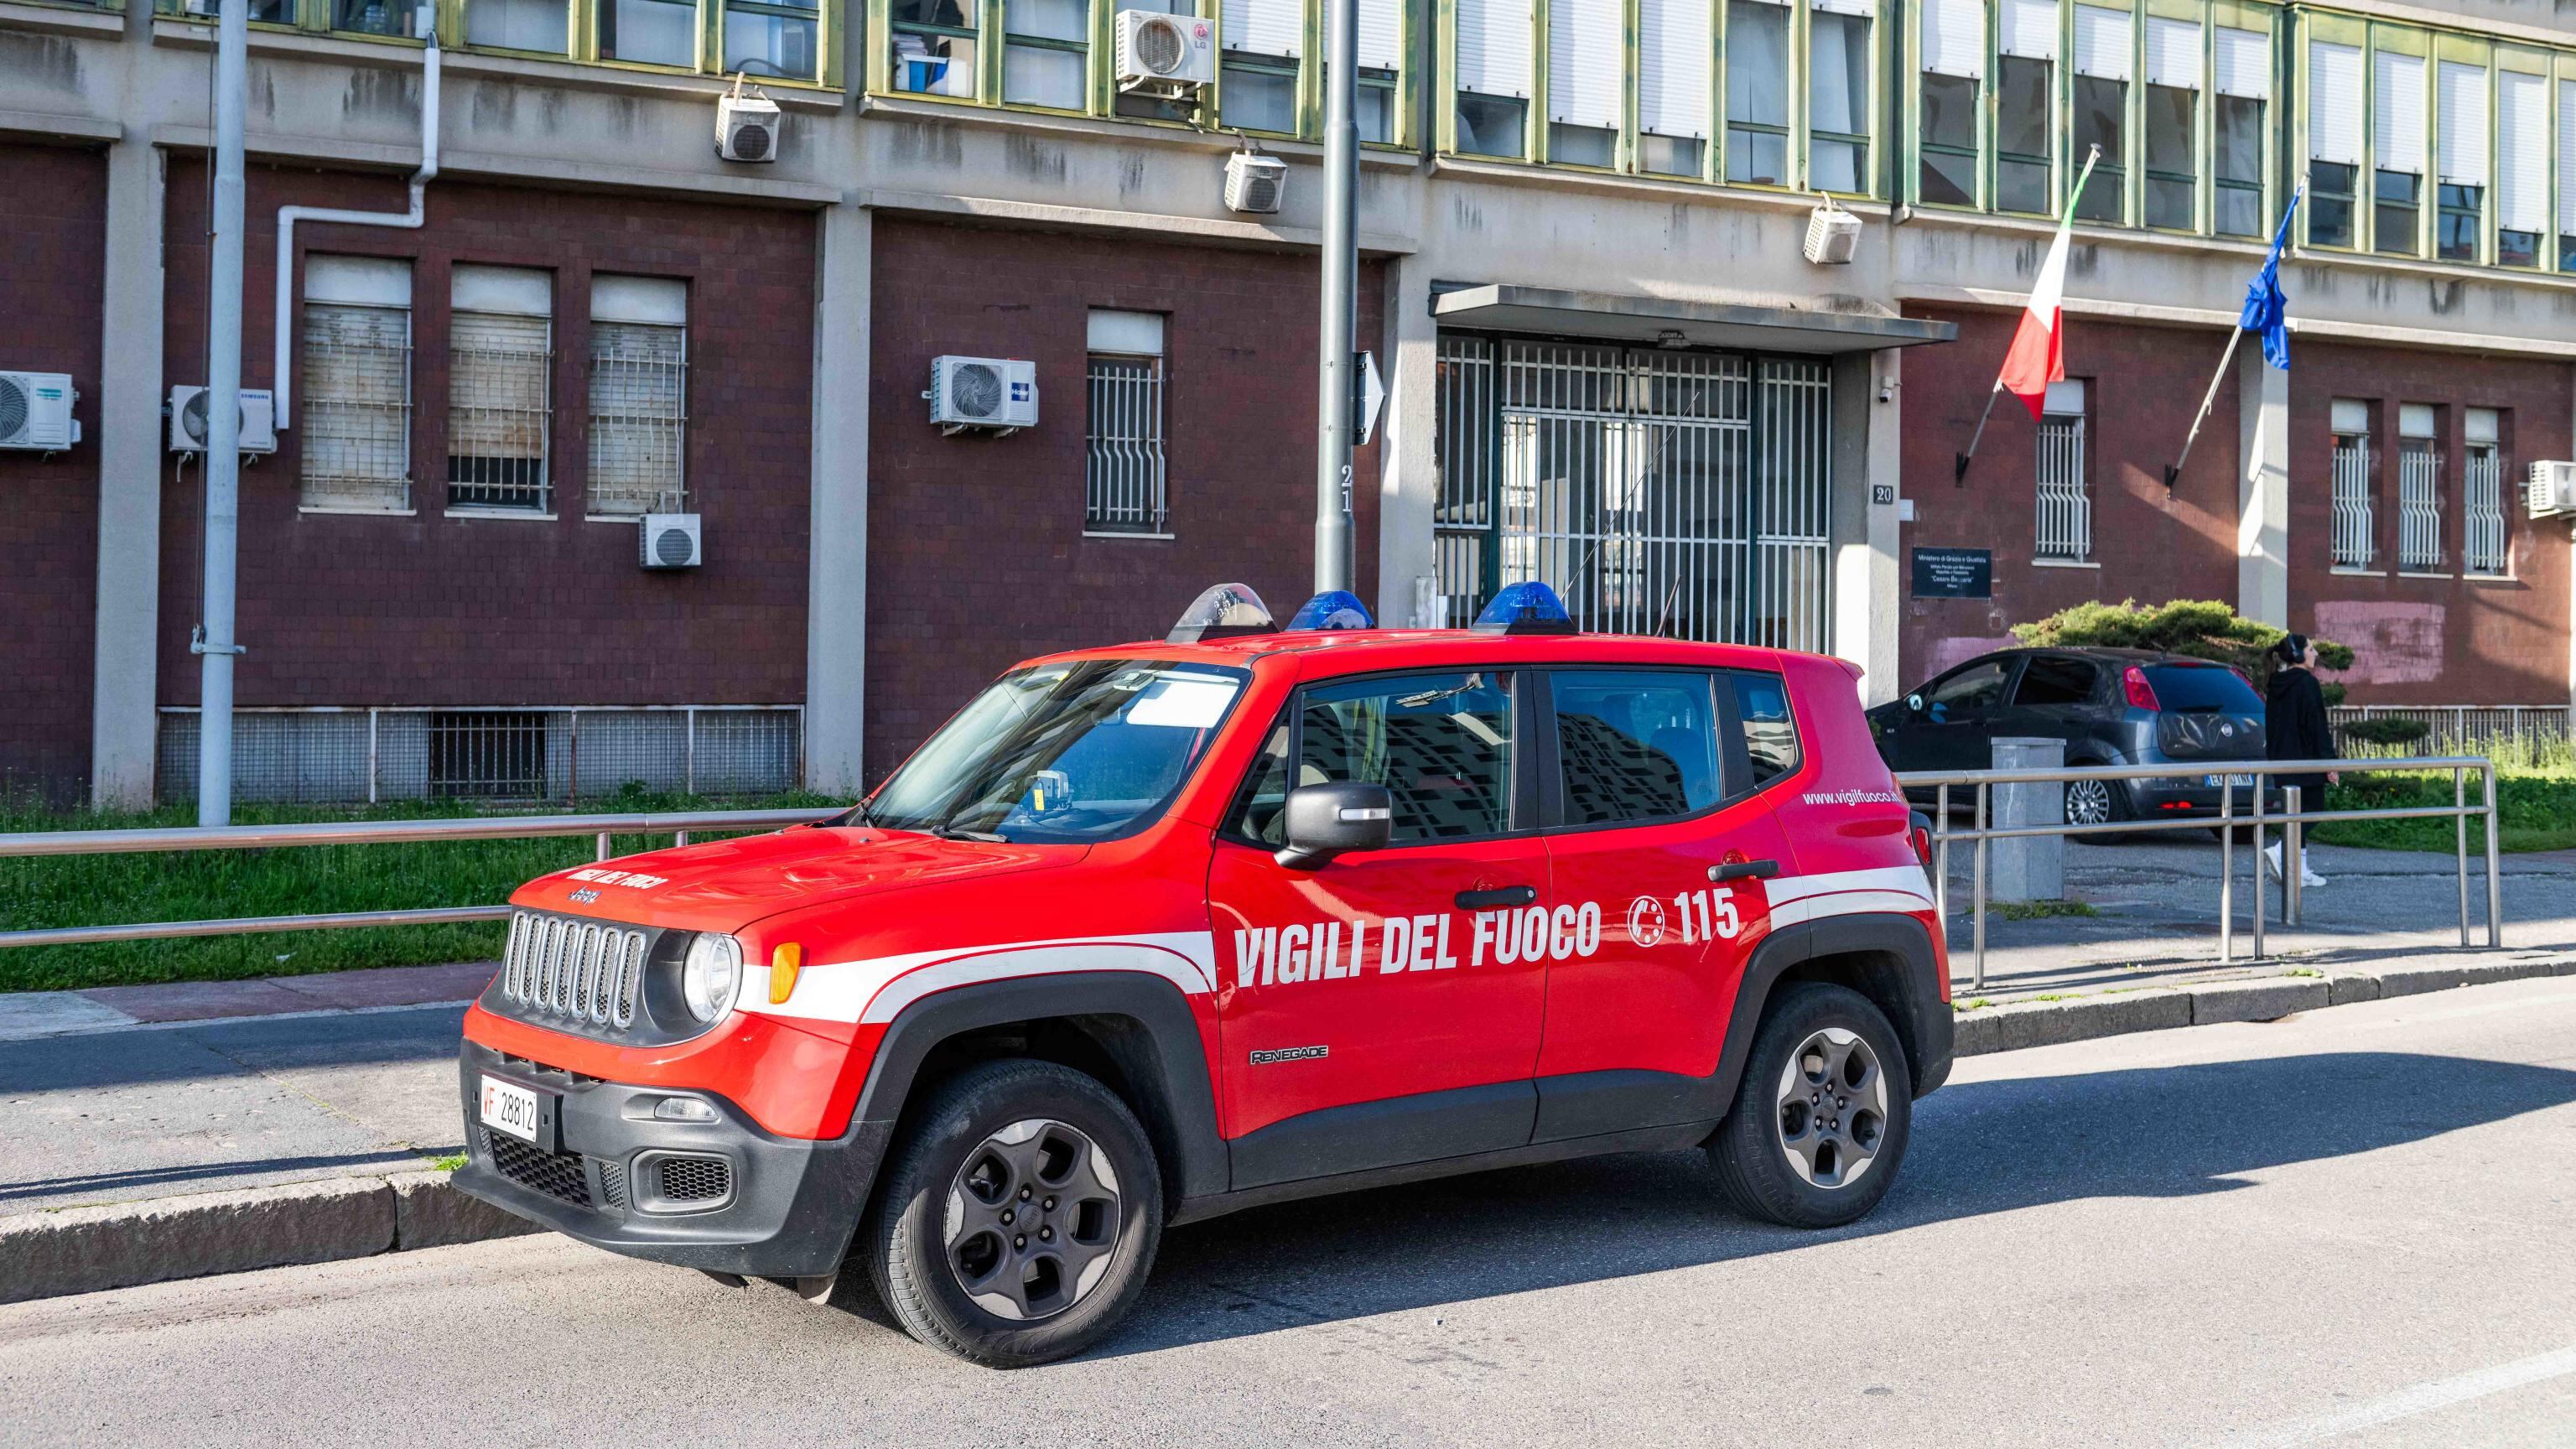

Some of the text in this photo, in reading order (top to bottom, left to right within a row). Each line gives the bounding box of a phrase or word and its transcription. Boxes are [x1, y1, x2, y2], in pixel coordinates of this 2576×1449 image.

[1877, 486, 1892, 502] 20
[568, 886, 602, 906] Jeep
[1234, 887, 1739, 988] VIGILI DEL FUOCO 115
[1250, 1046, 1328, 1065] RENEGADE
[484, 1084, 534, 1131] VF 28812
